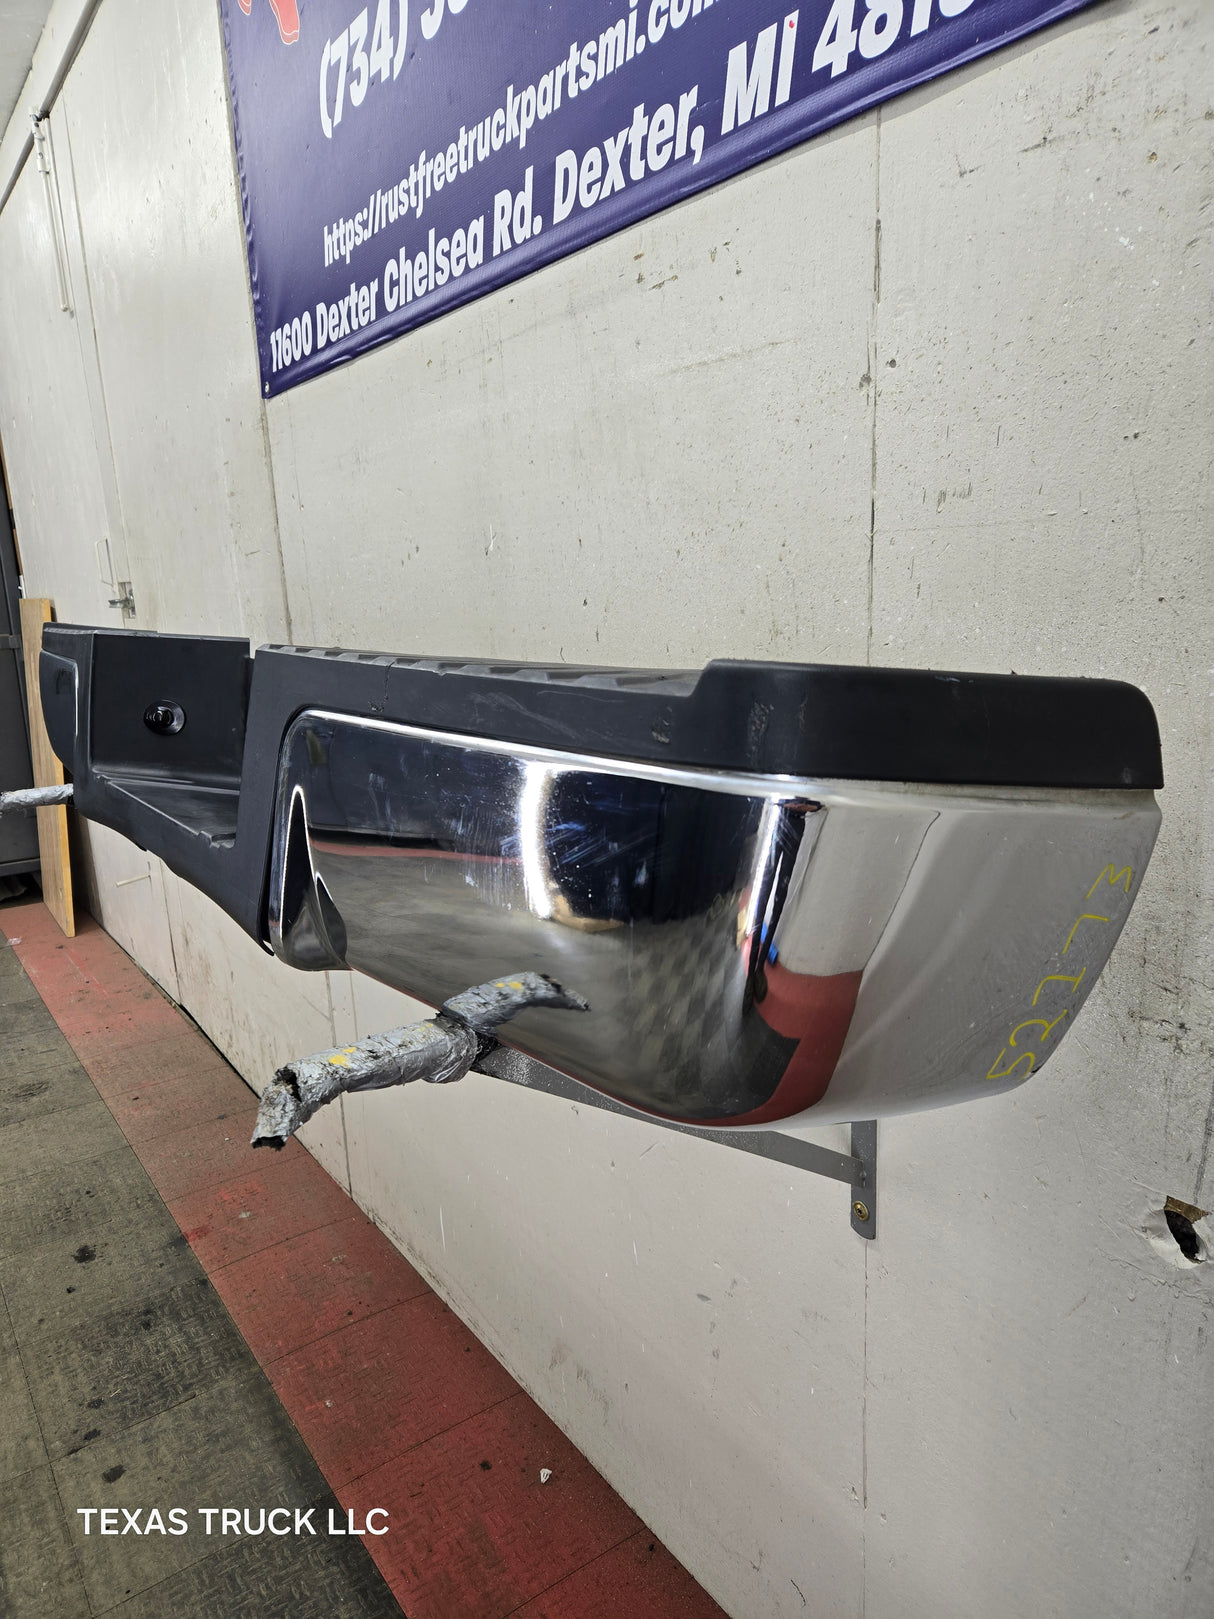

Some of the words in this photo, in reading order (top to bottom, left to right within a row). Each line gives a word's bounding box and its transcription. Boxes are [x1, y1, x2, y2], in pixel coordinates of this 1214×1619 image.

[270, 311, 312, 372] 11600
[316, 279, 378, 350] Dexter
[384, 215, 484, 312] Chelsea
[493, 165, 543, 257] Rd.
[553, 85, 705, 224] Dexter,
[720, 10, 799, 135] MI
[319, 0, 408, 139] (734)
